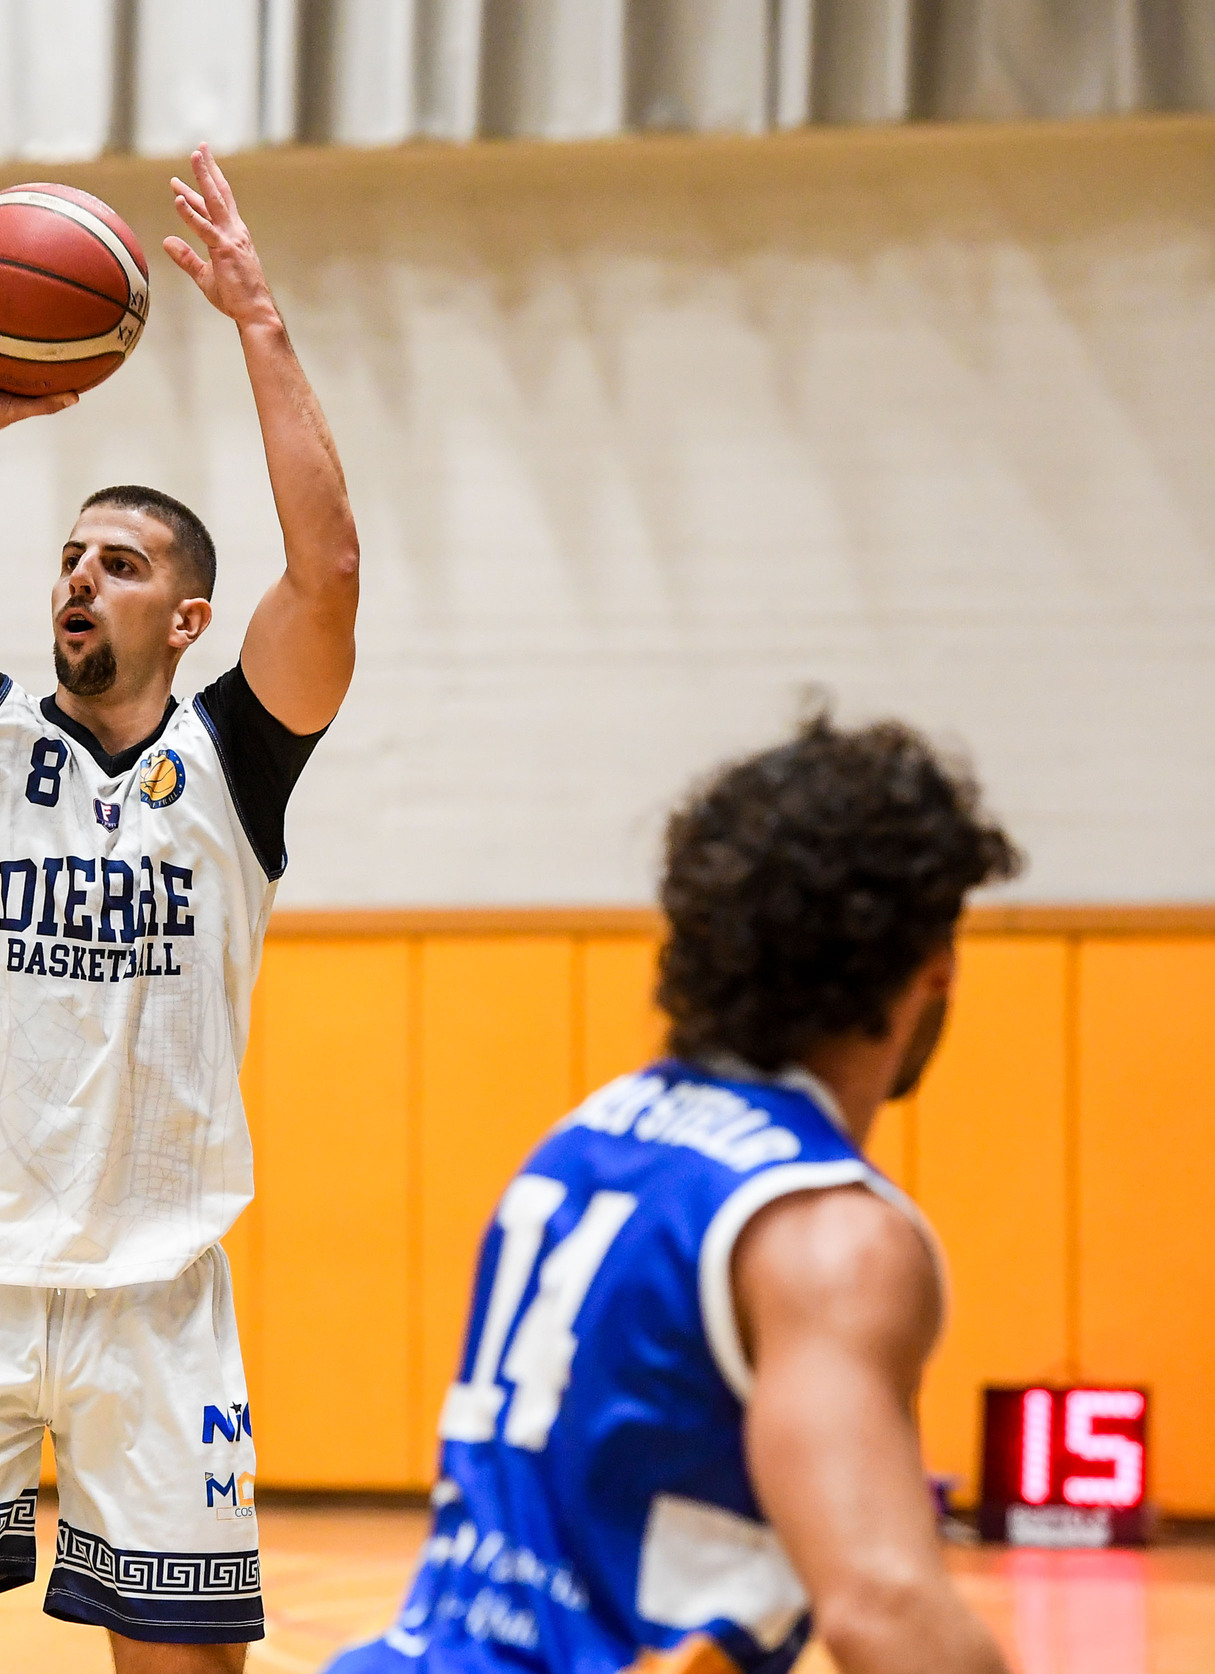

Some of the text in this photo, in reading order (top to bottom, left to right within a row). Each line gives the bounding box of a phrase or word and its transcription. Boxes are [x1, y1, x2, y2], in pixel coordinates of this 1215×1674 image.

[25, 737, 68, 808] 8
[0, 856, 195, 943] DIERRE
[438, 1173, 639, 1453] 14
[1020, 1387, 1145, 1507] 15
